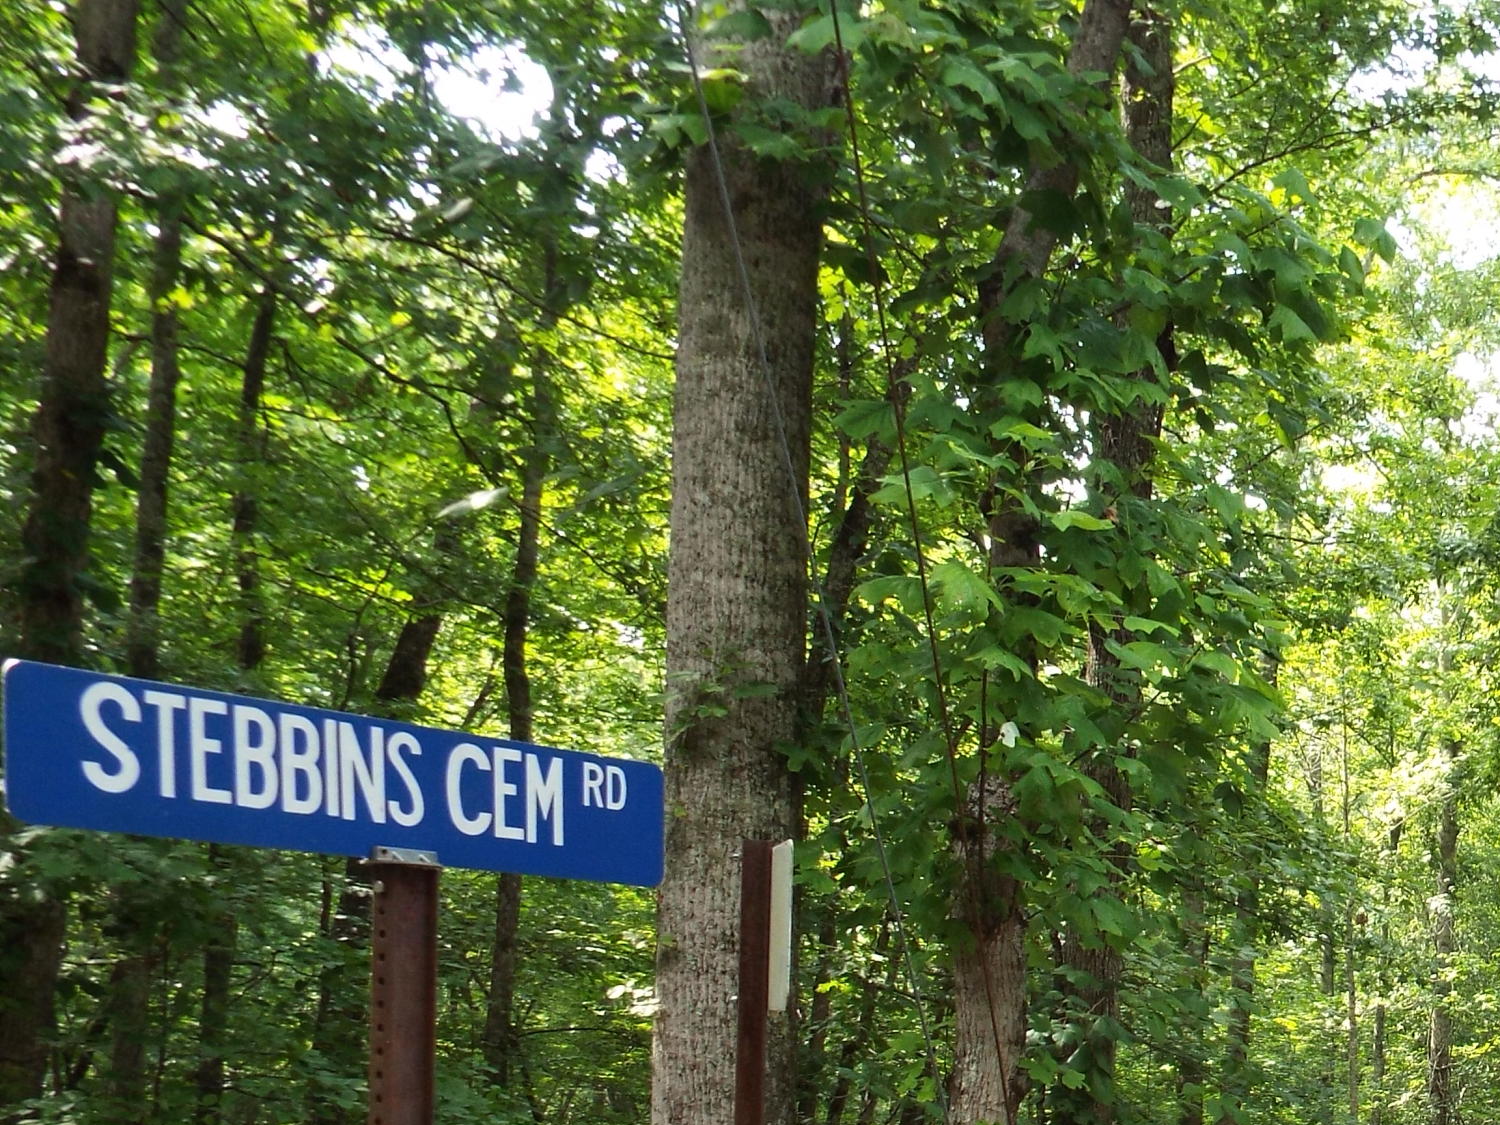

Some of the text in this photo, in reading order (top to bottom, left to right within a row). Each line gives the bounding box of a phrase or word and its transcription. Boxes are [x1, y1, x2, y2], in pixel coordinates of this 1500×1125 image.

[79, 681, 627, 847] STEBBINS CEM RD
